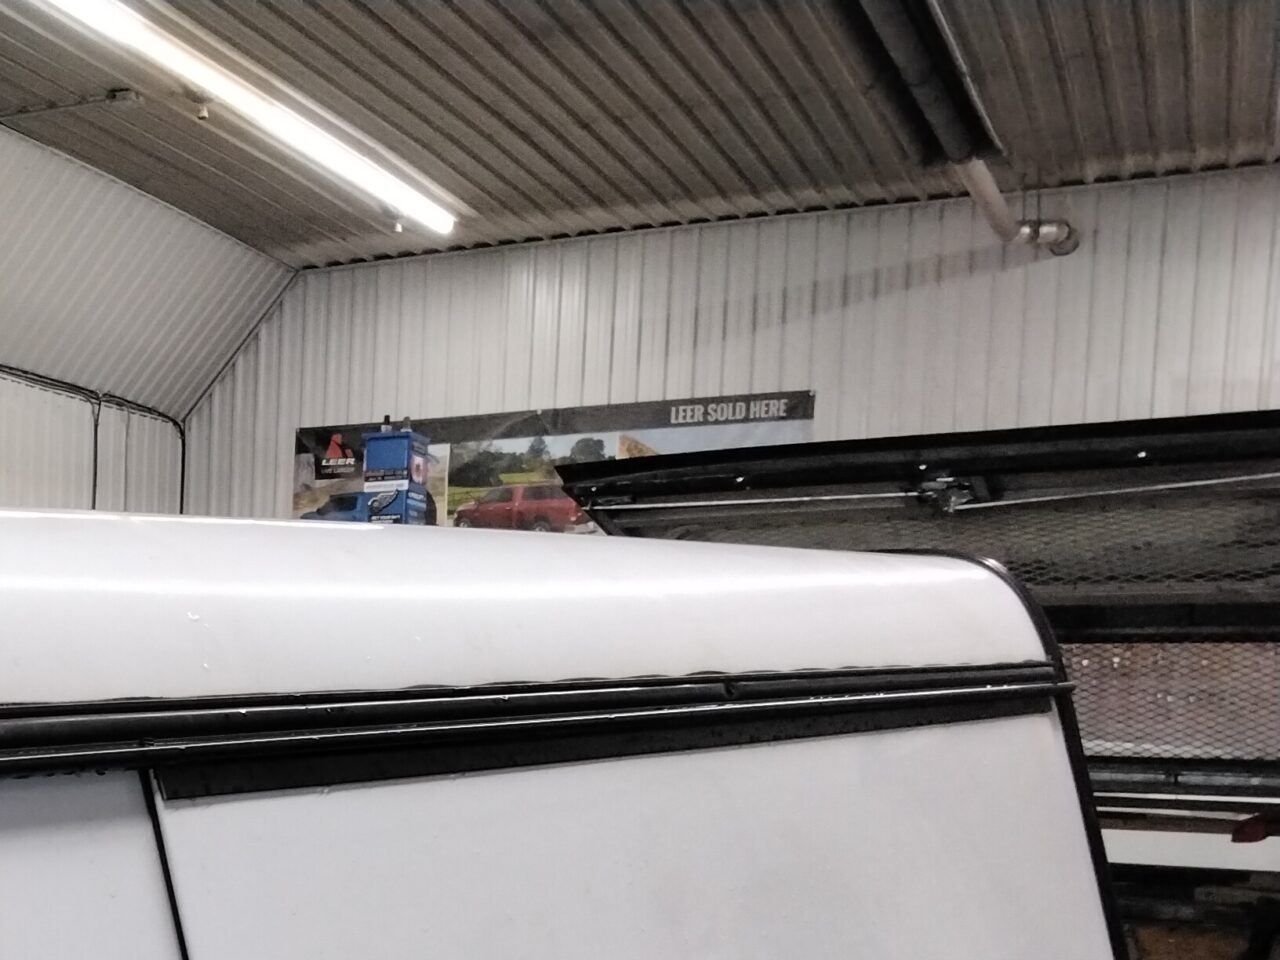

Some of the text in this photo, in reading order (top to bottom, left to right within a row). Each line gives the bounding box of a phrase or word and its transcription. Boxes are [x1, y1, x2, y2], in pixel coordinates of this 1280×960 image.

[670, 399, 789, 424] LEER SOLD HERE
[321, 457, 356, 466] LEER
